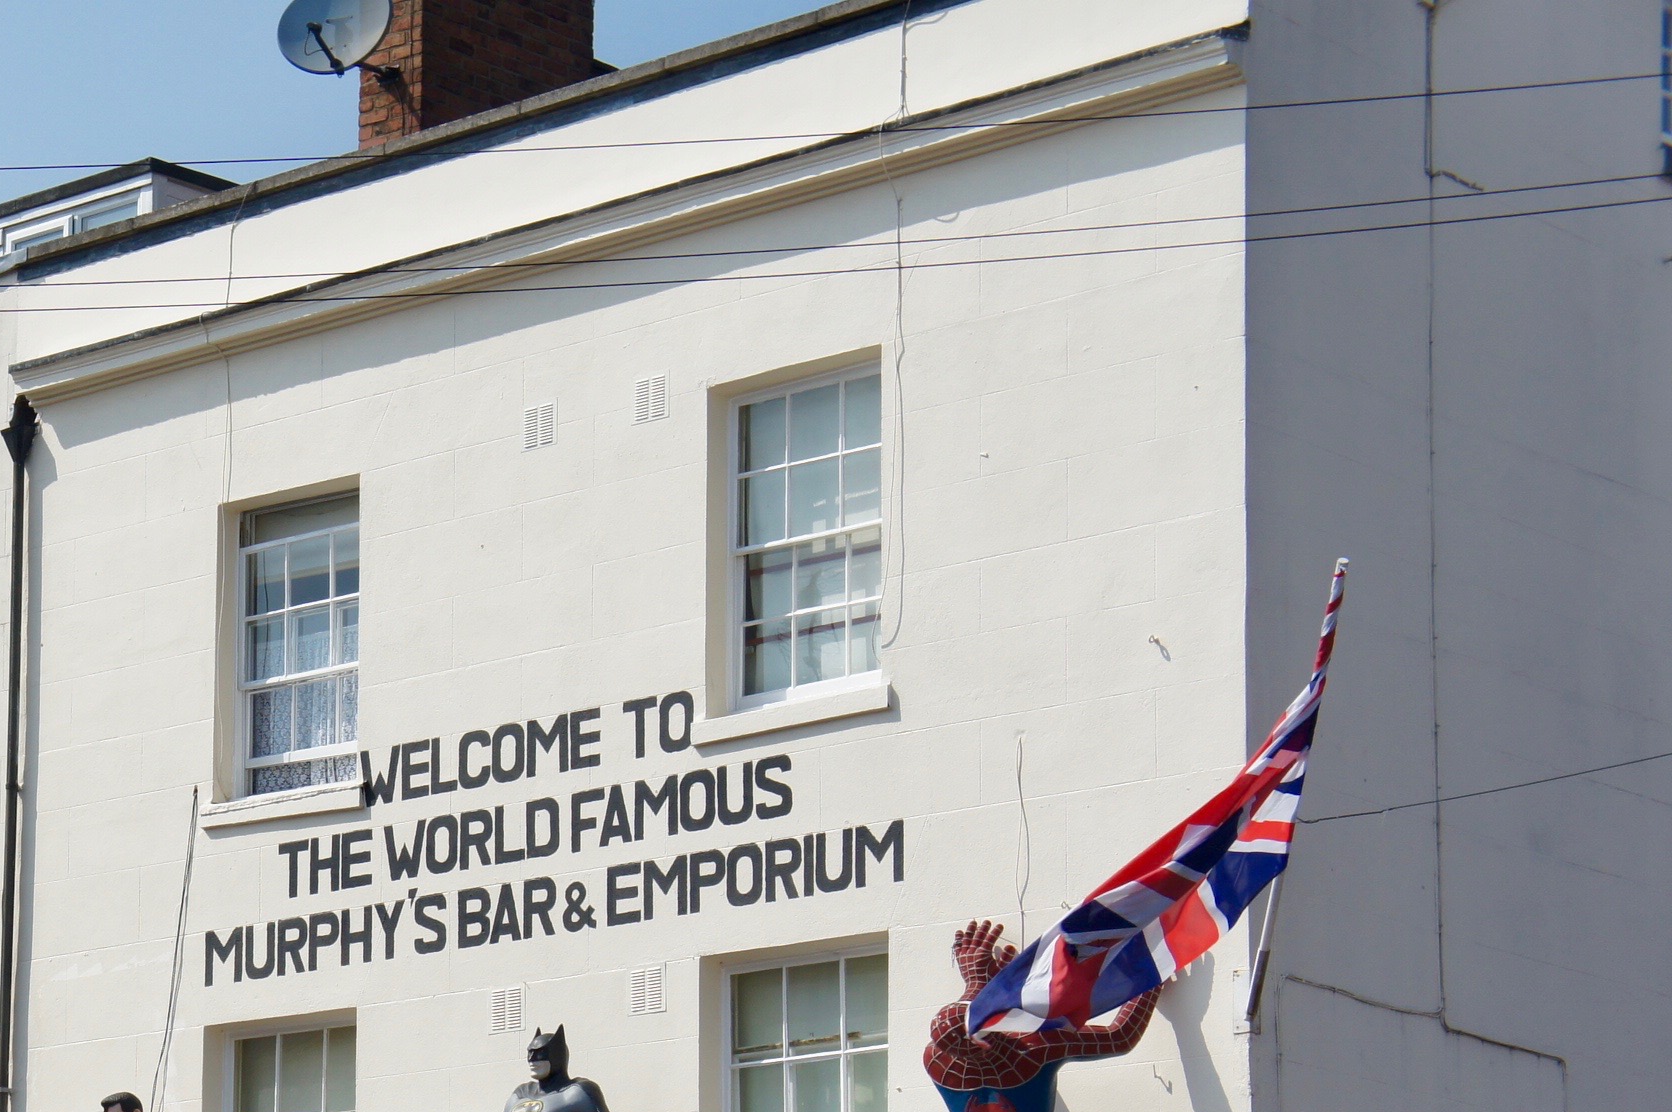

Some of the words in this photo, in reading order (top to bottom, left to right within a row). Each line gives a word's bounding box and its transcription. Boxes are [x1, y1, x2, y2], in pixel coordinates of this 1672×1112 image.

[361, 706, 601, 807] WELCOME
[623, 690, 694, 759] TO
[279, 830, 373, 898] THE
[385, 797, 559, 881] WORLD
[570, 754, 793, 853] FAMOUS
[204, 889, 448, 987] MURPHY'S
[457, 877, 555, 949] BAR
[562, 885, 597, 932] &
[606, 819, 905, 926] EMPORIUM
